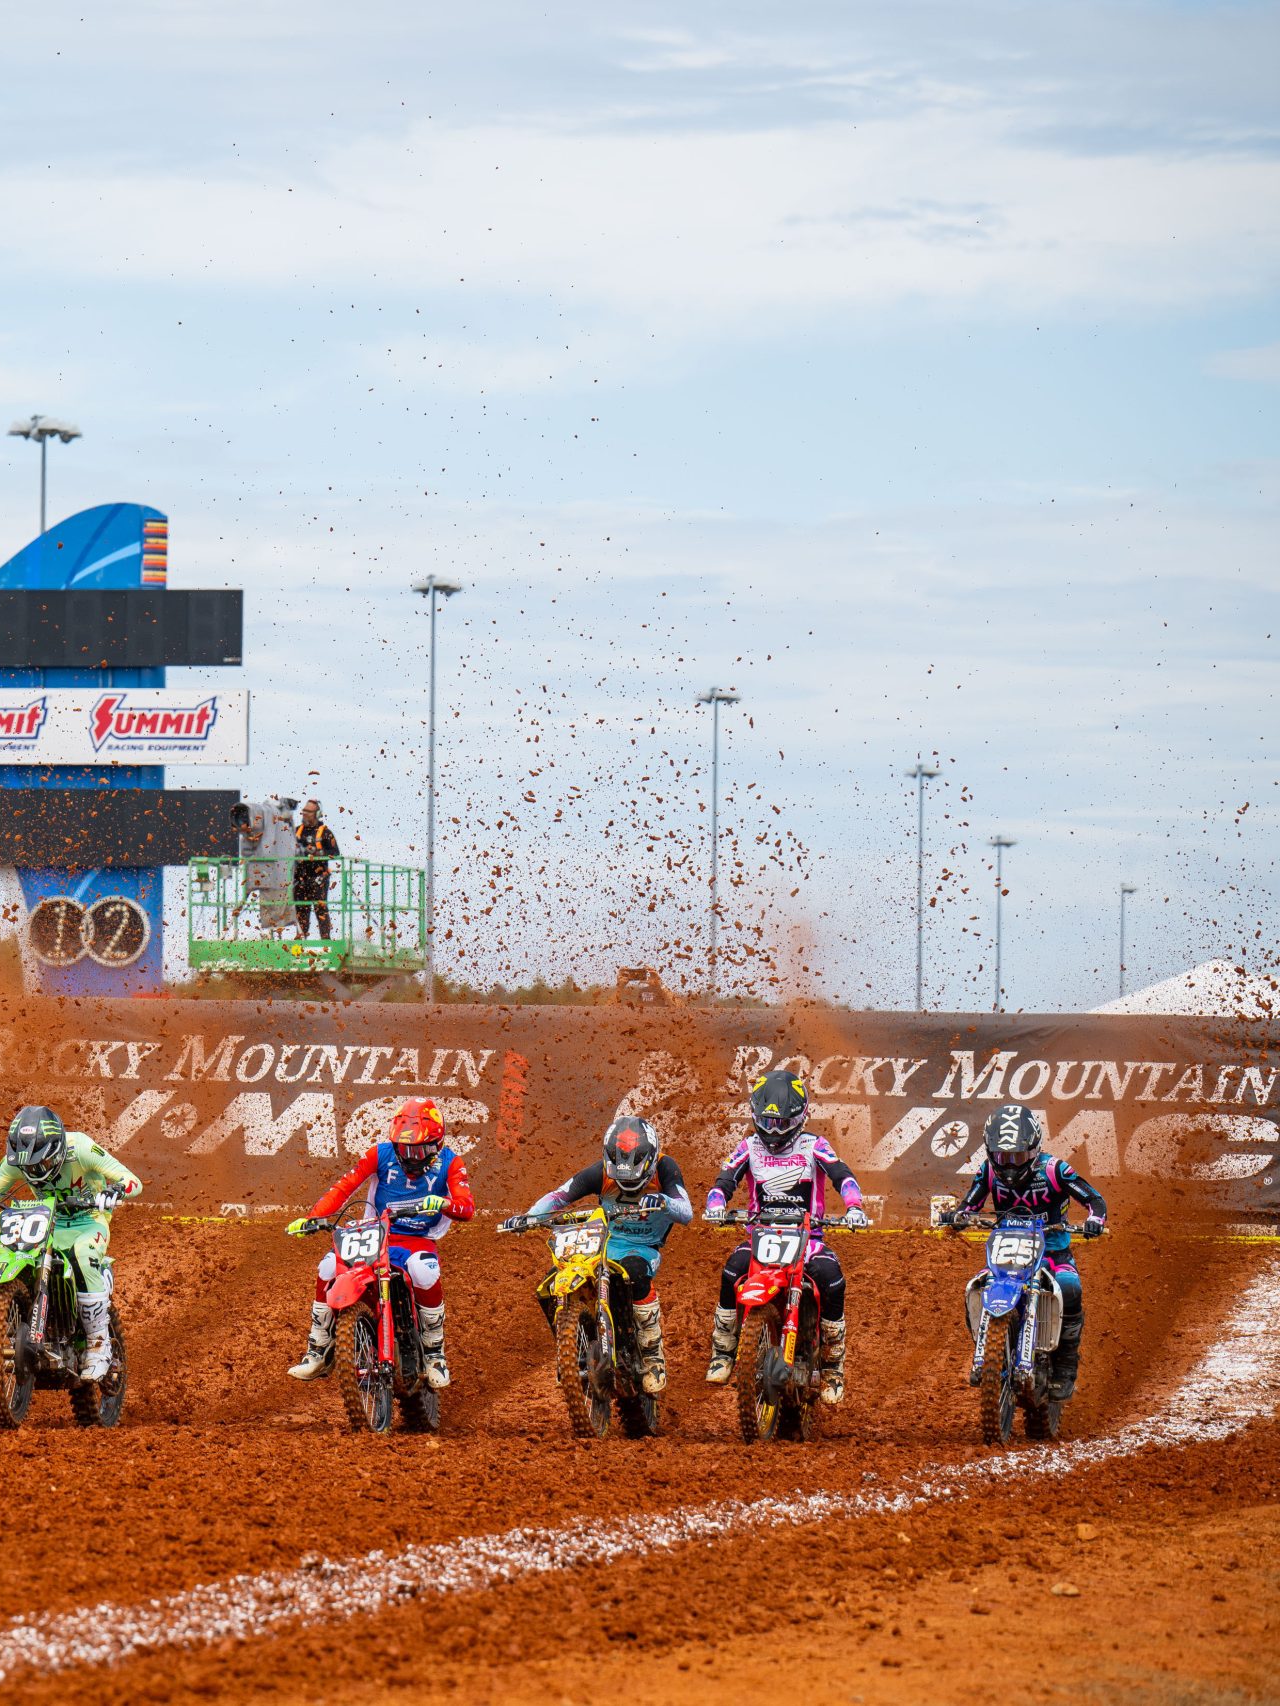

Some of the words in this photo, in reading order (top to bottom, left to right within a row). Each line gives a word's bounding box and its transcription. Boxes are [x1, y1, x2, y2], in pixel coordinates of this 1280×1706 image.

[163, 1034, 496, 1088] MOUNTAIN
[932, 1050, 1280, 1106] MOUNTAIN
[1000, 1104, 1023, 1142] FXR
[387, 1169, 438, 1192] FLY
[997, 1187, 1052, 1207] FXR
[0, 1214, 50, 1246] 30
[341, 1229, 381, 1260] 63
[554, 1228, 602, 1260] 85
[756, 1234, 801, 1264] 67
[991, 1235, 1041, 1266] 125
[1023, 1318, 1034, 1360] DUNLOP
